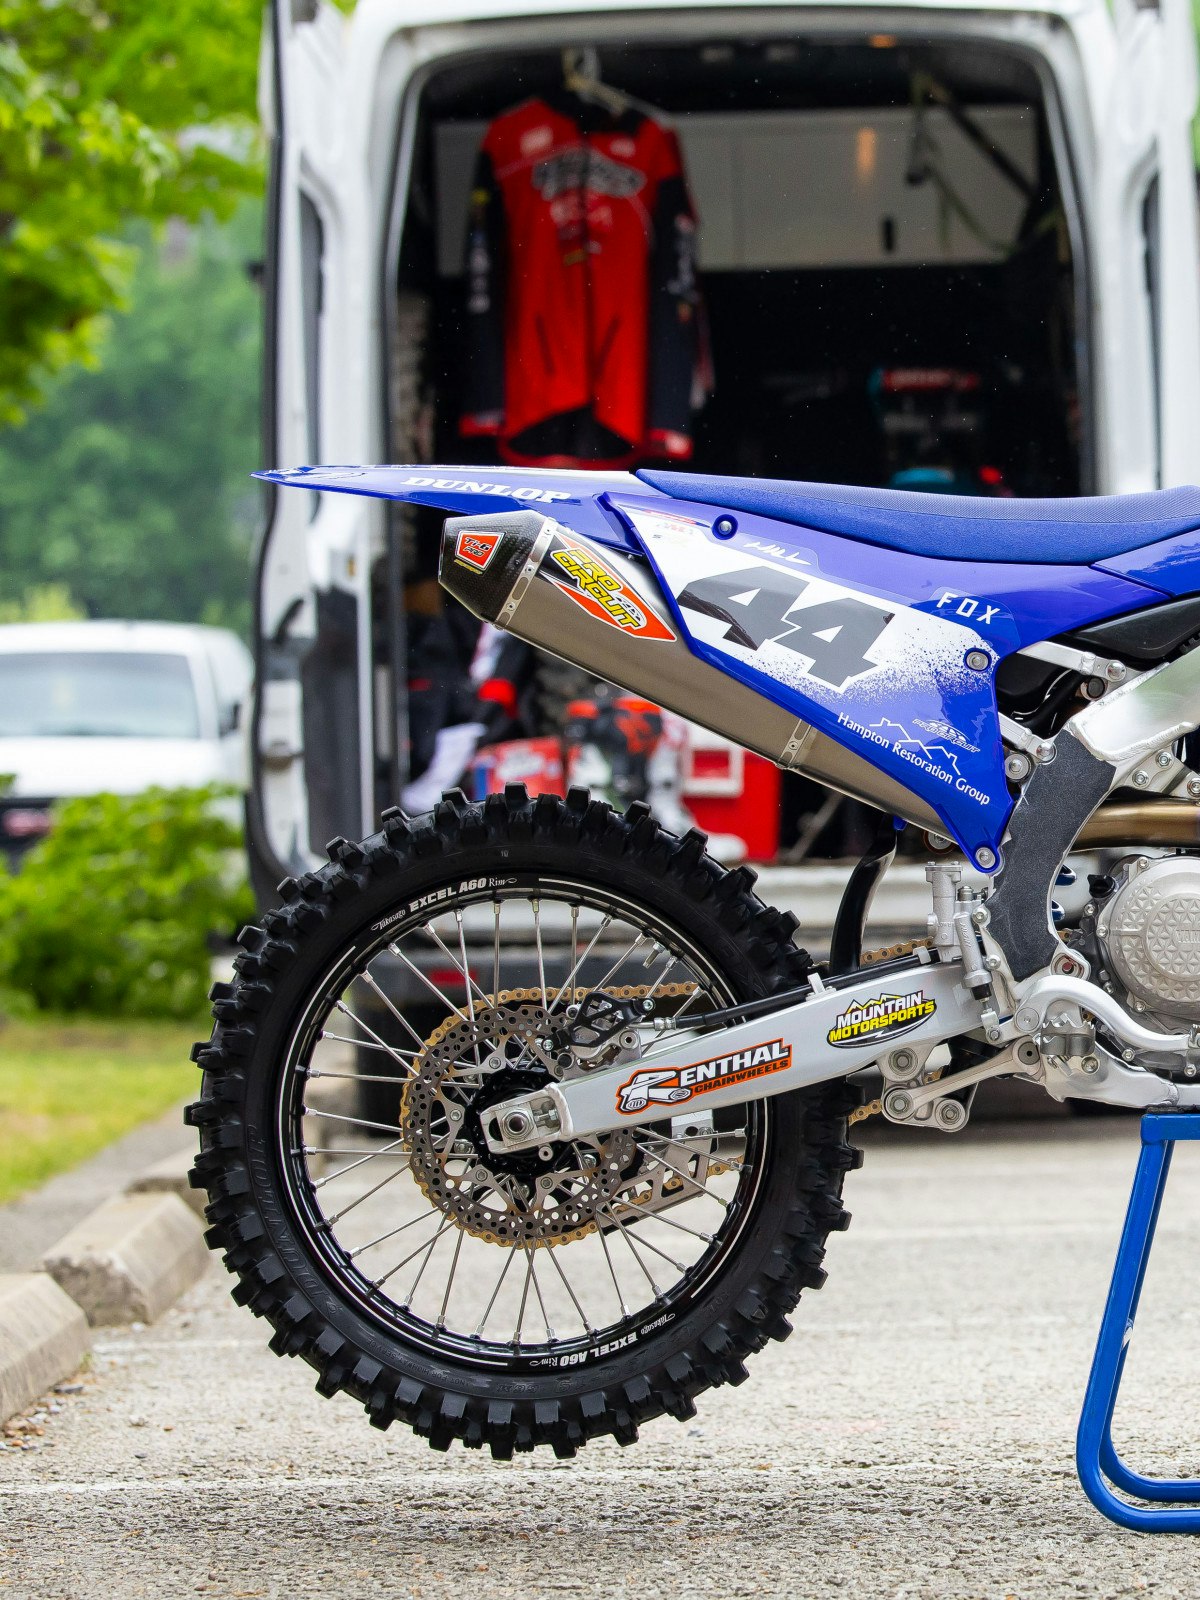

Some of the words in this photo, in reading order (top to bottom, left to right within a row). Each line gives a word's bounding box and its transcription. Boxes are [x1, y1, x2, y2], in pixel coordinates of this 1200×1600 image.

[400, 477, 572, 503] DUNLOP
[552, 551, 642, 628] CIRCUIT
[568, 550, 622, 591] PRO
[676, 566, 896, 688] 44
[936, 591, 1001, 625] FOX
[837, 712, 889, 749] Hampton
[891, 741, 953, 785] Restoration
[955, 777, 990, 806] Group
[371, 910, 406, 930] Takasago
[408, 887, 457, 912] EXCEL
[459, 878, 487, 893] A60
[489, 877, 511, 887] Rim
[829, 1000, 935, 1043] MOTORSPORTS
[836, 993, 923, 1029] MOUNTAIN
[694, 1059, 790, 1094] CHAINWHEELS
[559, 1351, 588, 1367] A60
[590, 1332, 639, 1357] EXCEL
